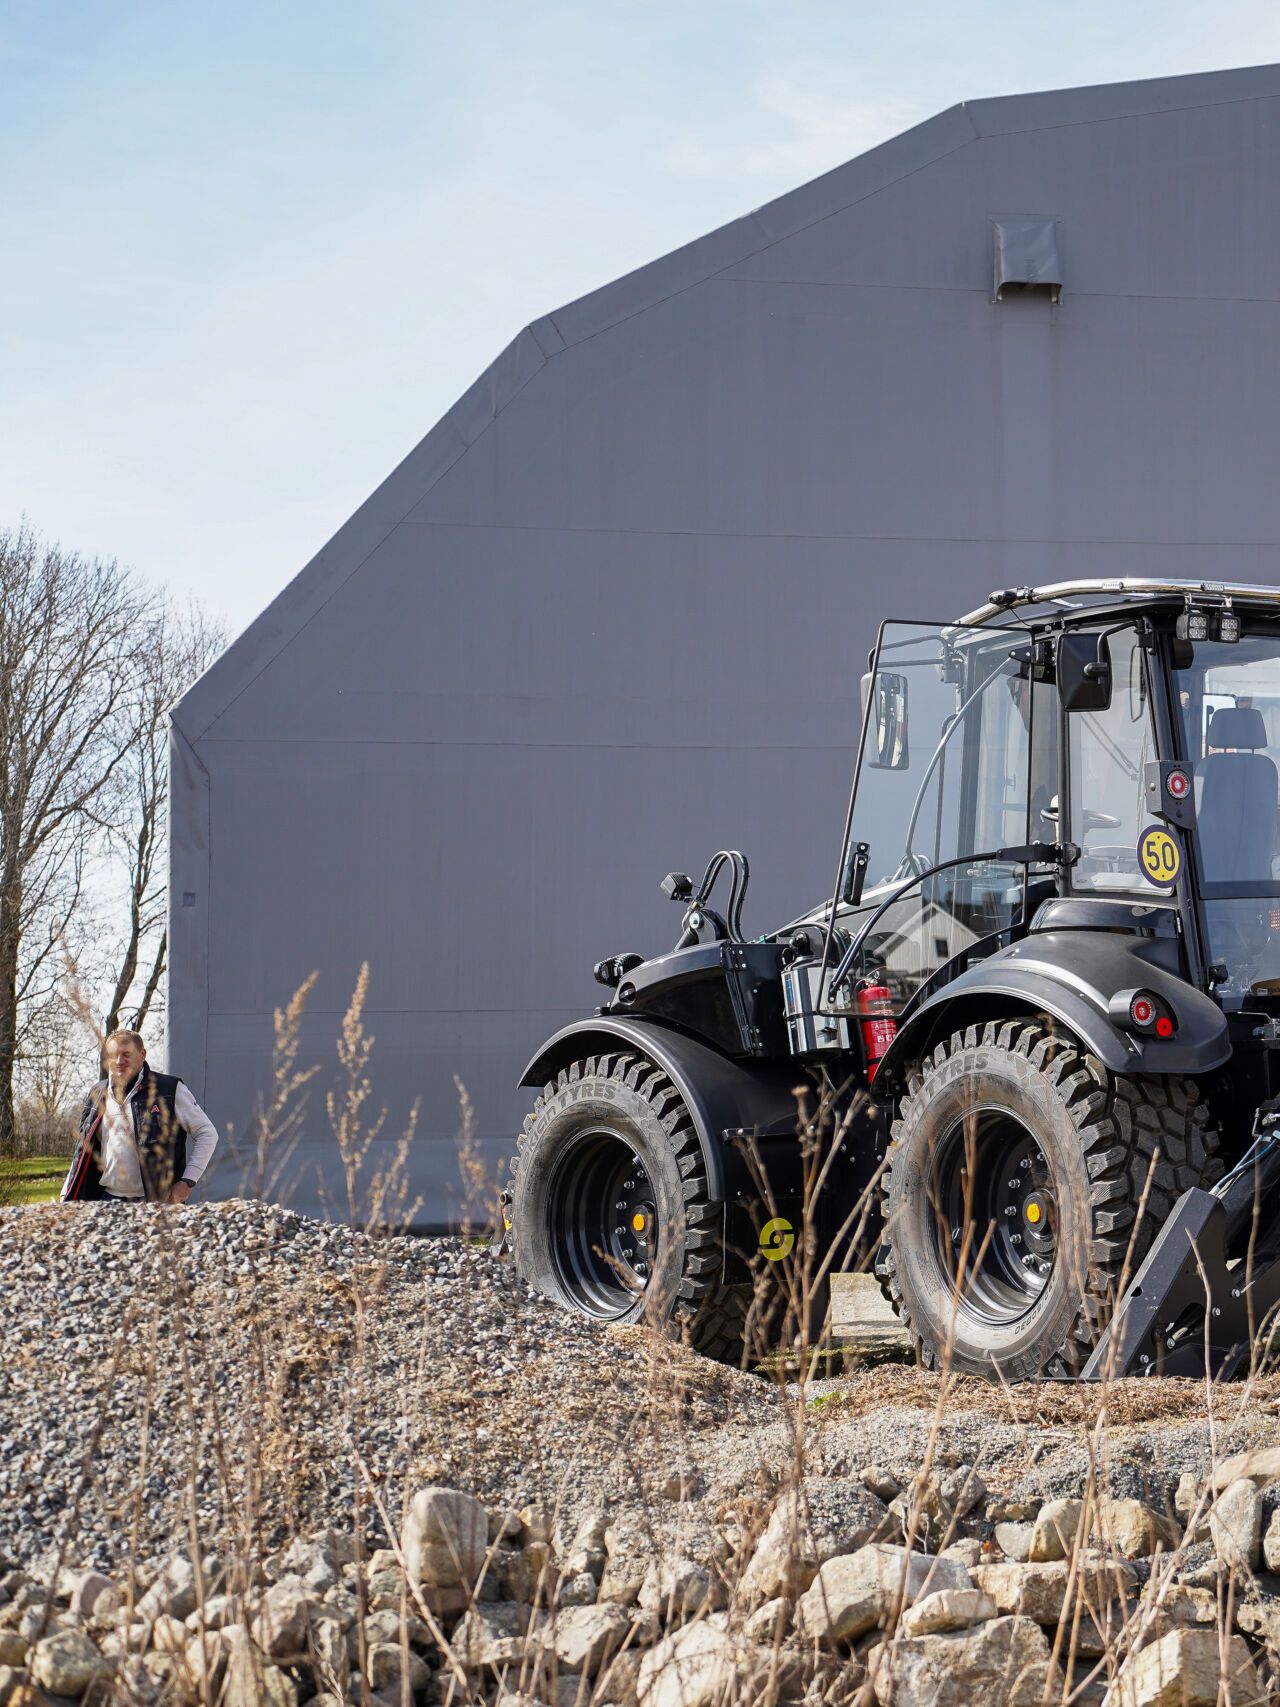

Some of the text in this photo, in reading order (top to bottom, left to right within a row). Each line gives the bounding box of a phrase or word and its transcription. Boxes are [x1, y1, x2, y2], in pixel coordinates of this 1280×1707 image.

[1146, 840, 1176, 872] 50
[925, 1052, 989, 1098] TYRES
[558, 1082, 617, 1108] TYRES
